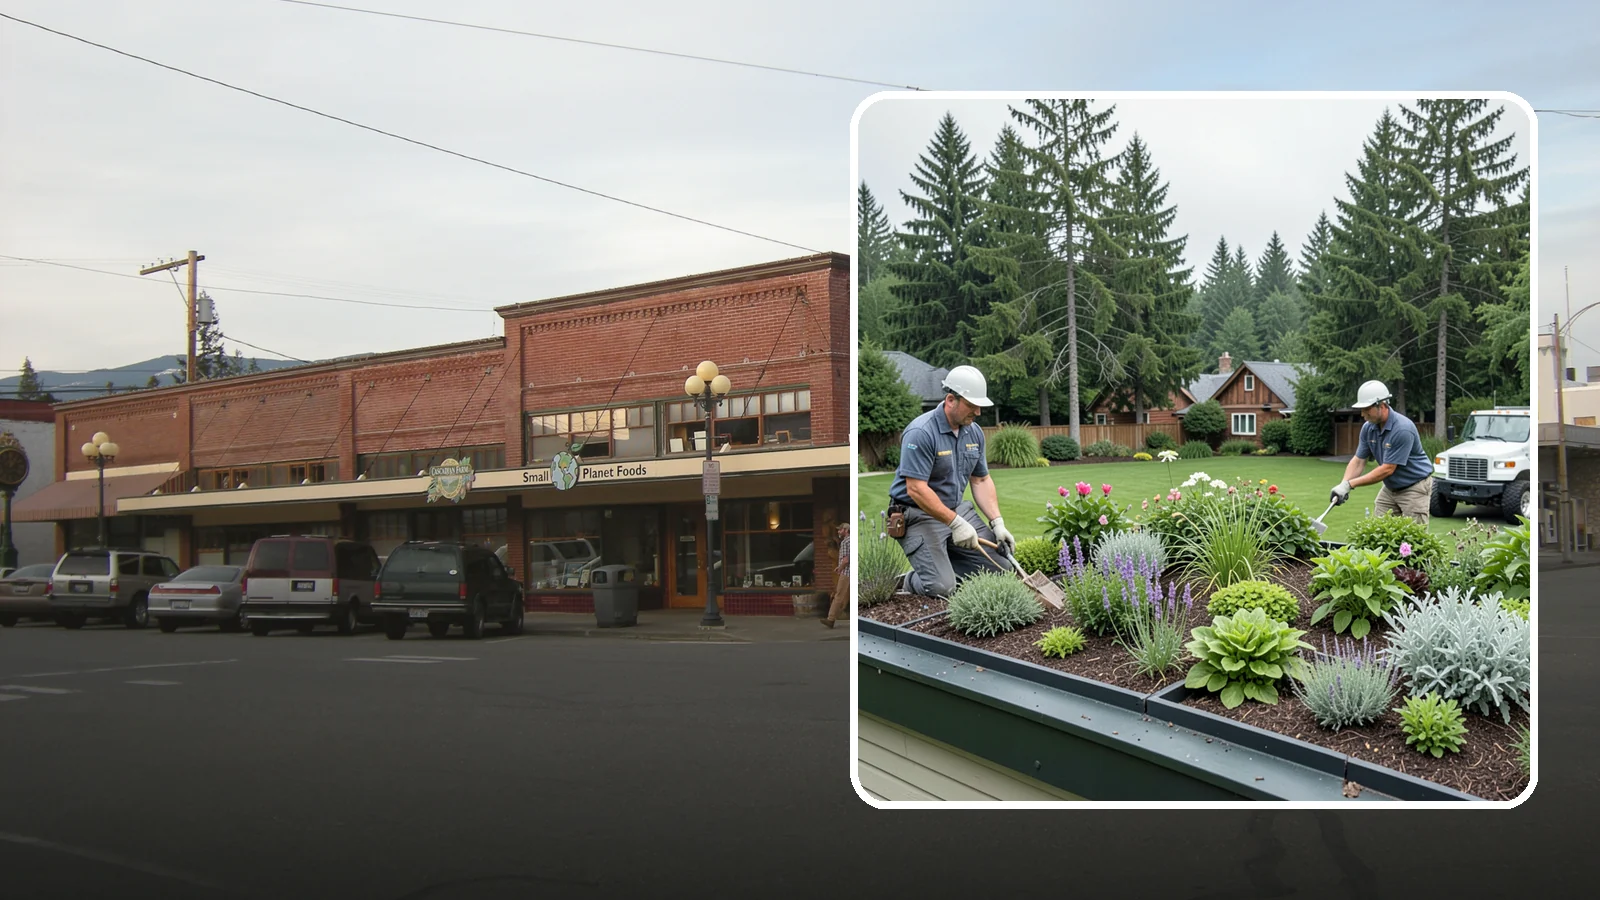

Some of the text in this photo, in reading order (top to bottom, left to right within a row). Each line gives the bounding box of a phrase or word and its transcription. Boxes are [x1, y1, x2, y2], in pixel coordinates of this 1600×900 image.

[523, 464, 647, 483] Small Planet Foods
